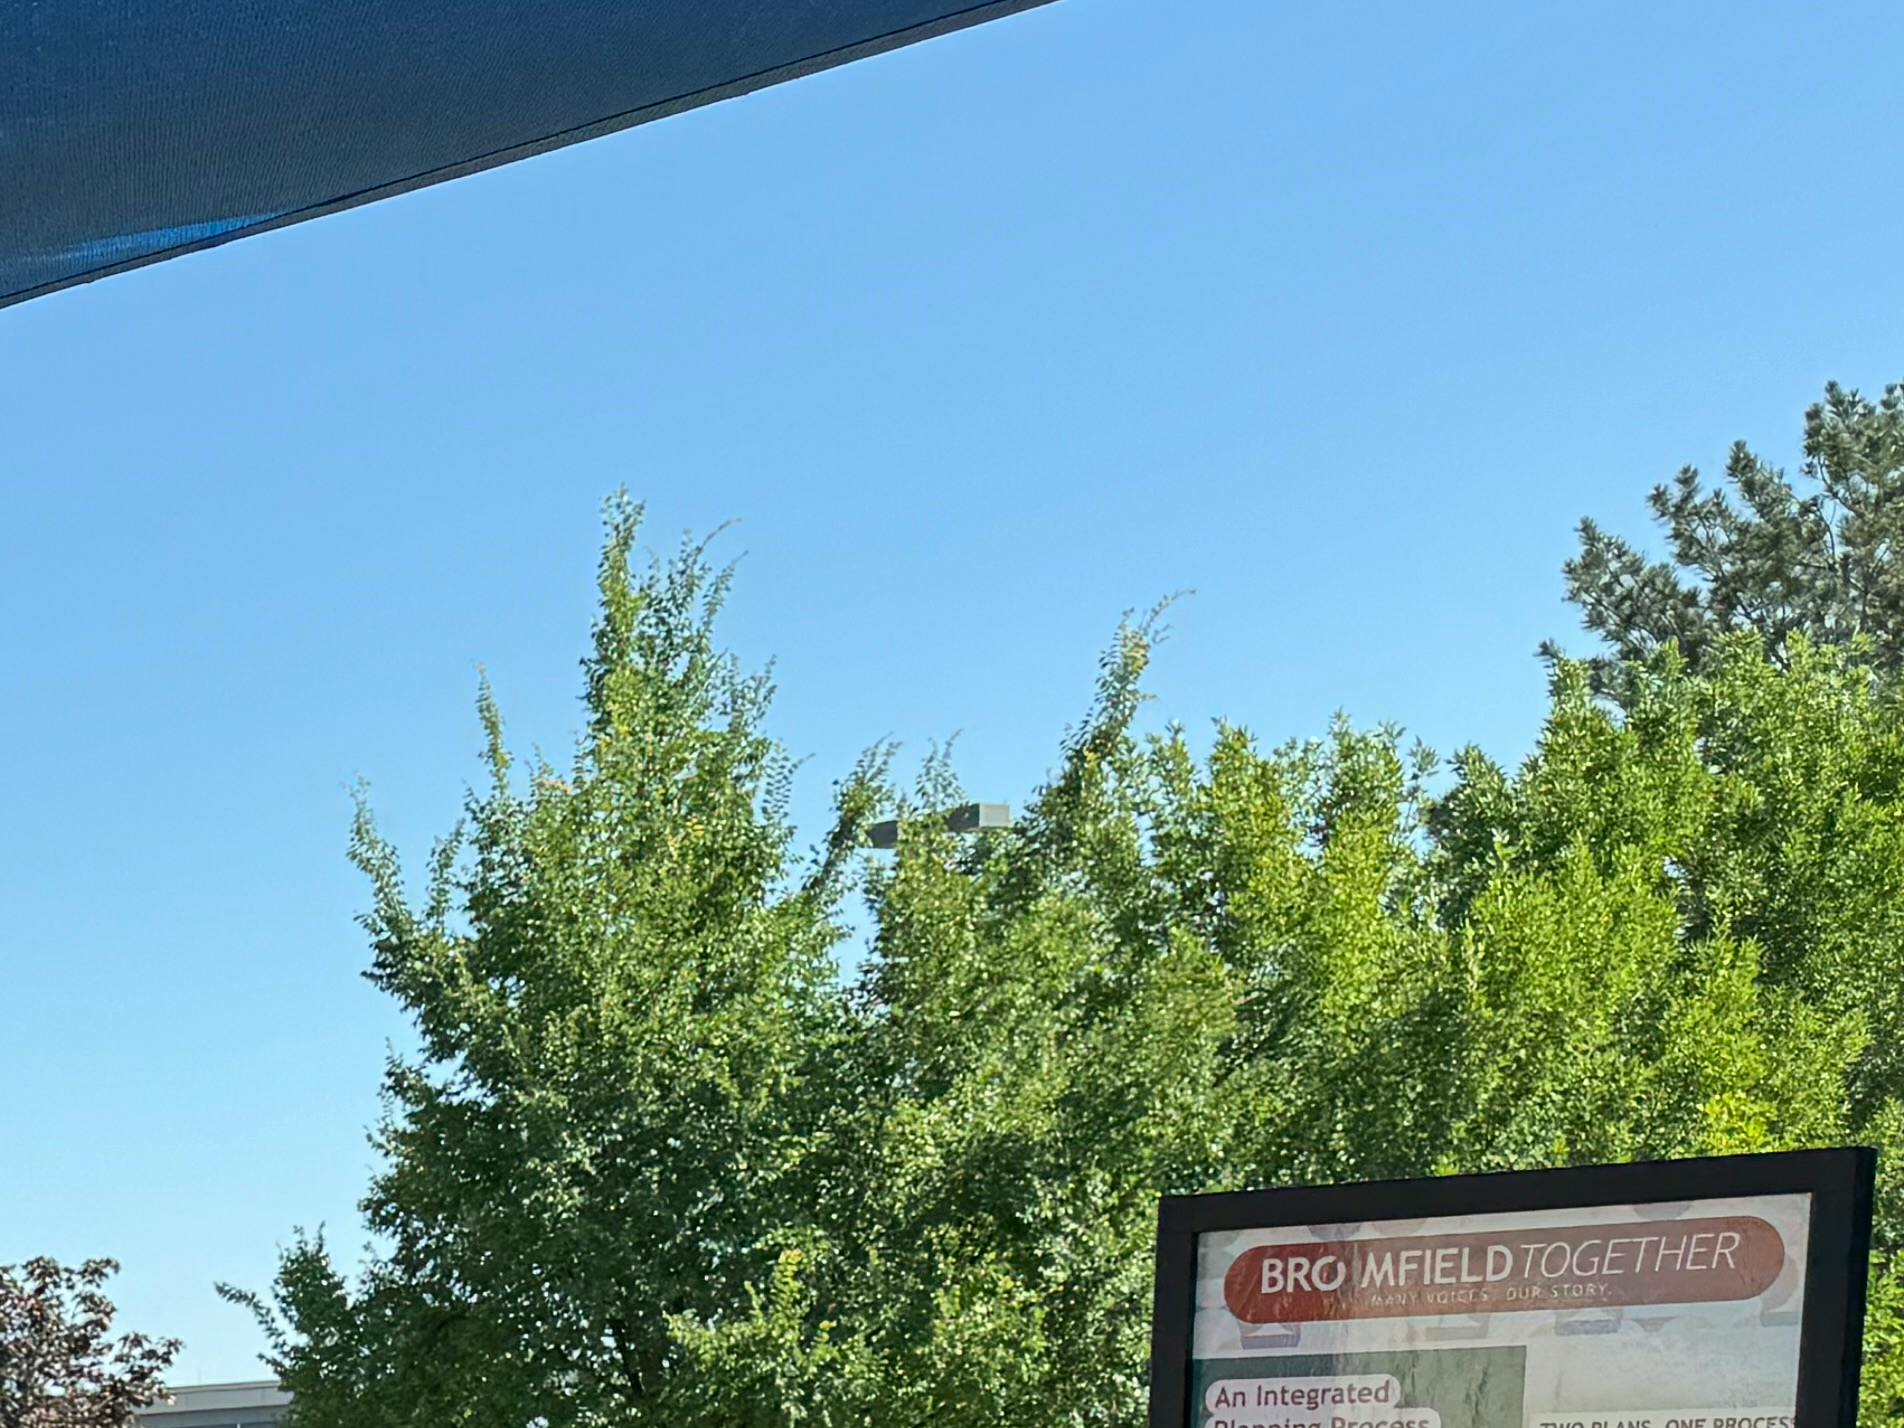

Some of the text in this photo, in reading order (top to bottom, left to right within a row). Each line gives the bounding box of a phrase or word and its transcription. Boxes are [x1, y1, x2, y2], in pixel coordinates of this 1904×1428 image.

[1520, 1231, 1741, 1282] TOGETHER
[1214, 1380, 1390, 1411] An Integrated
